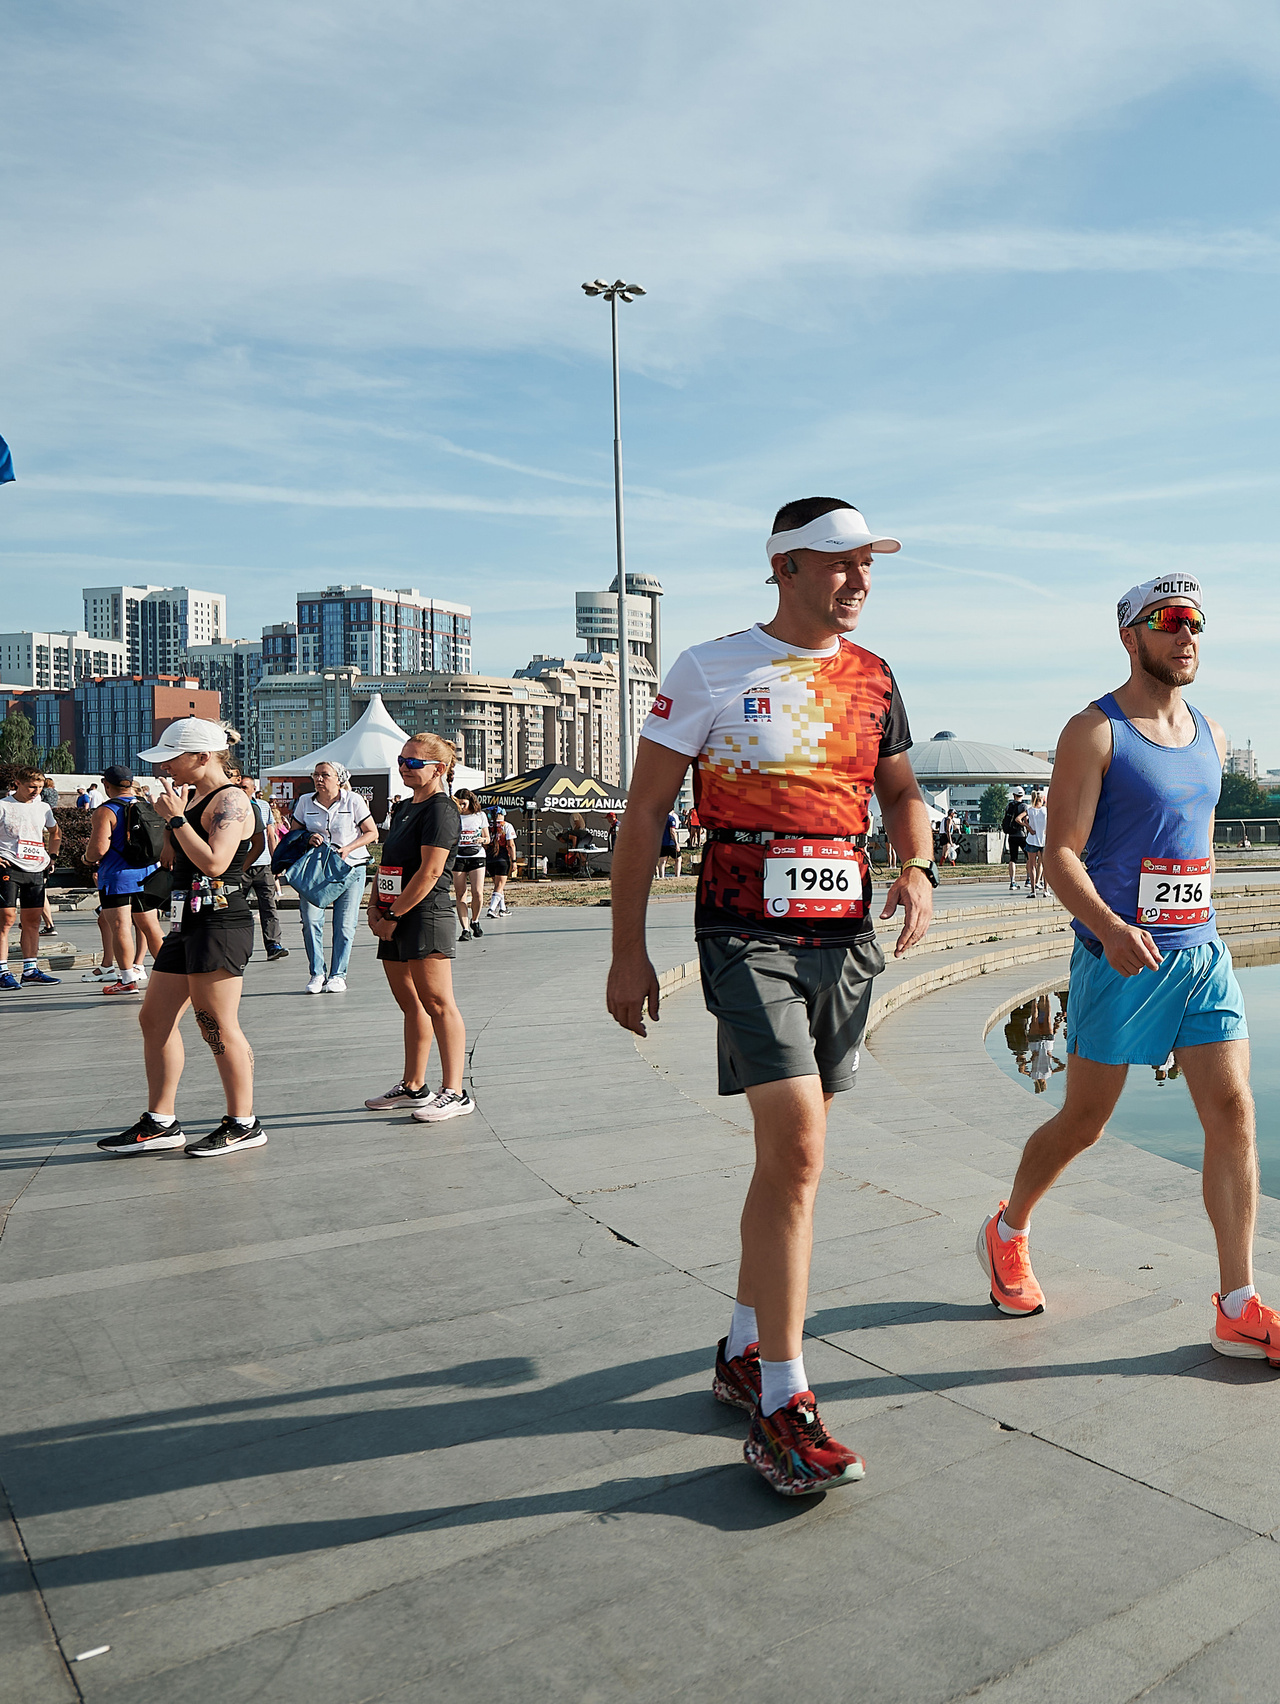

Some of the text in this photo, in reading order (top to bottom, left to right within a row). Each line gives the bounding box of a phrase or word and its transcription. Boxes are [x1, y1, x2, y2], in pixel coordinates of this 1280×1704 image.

[1154, 581, 1199, 593] MOLTENI
[475, 794, 524, 806] ORTMANIACS
[544, 797, 628, 809] SPORTMANIAC
[22, 846, 40, 855] 2604
[785, 868, 849, 892] 1986
[1155, 882, 1203, 903] 2136
[772, 898, 785, 912] C
[1145, 908, 1158, 918] B
